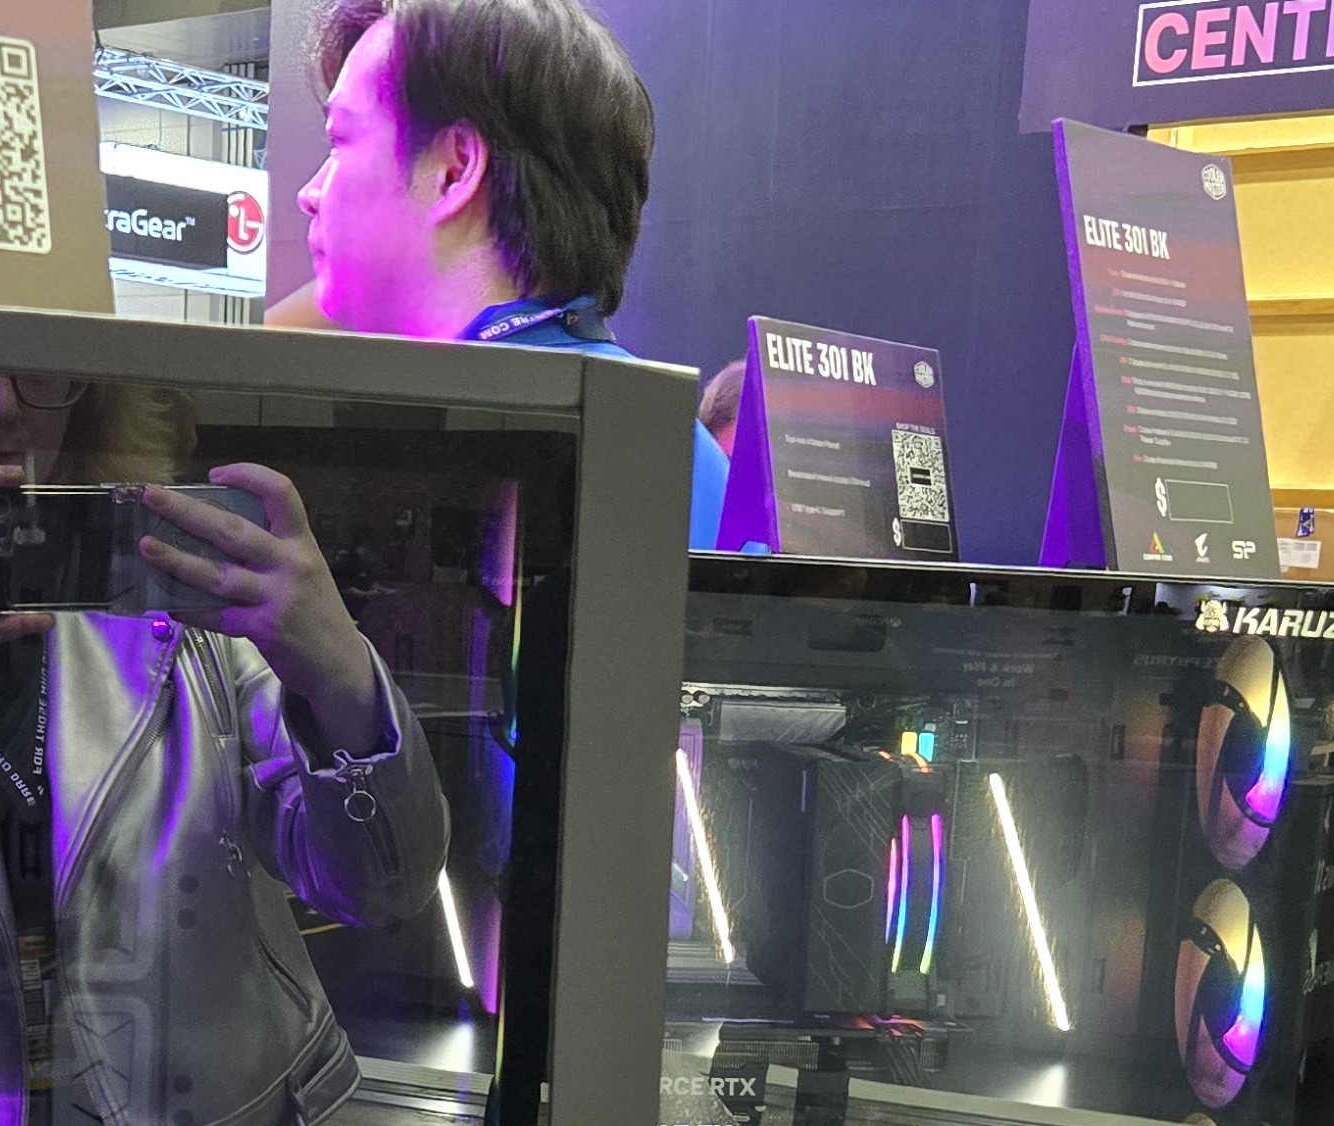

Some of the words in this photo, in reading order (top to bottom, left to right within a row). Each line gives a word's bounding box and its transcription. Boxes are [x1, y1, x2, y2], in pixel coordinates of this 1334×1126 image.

[1083, 215, 1123, 251] ELITE
[1125, 222, 1148, 256] 301
[1149, 229, 1170, 260] BK
[766, 333, 814, 375] ELITE
[816, 342, 849, 381] 301
[851, 349, 876, 386] BK
[1154, 477, 1167, 518] $
[1231, 540, 1256, 559] SP
[711, 1077, 756, 1097] RTX
